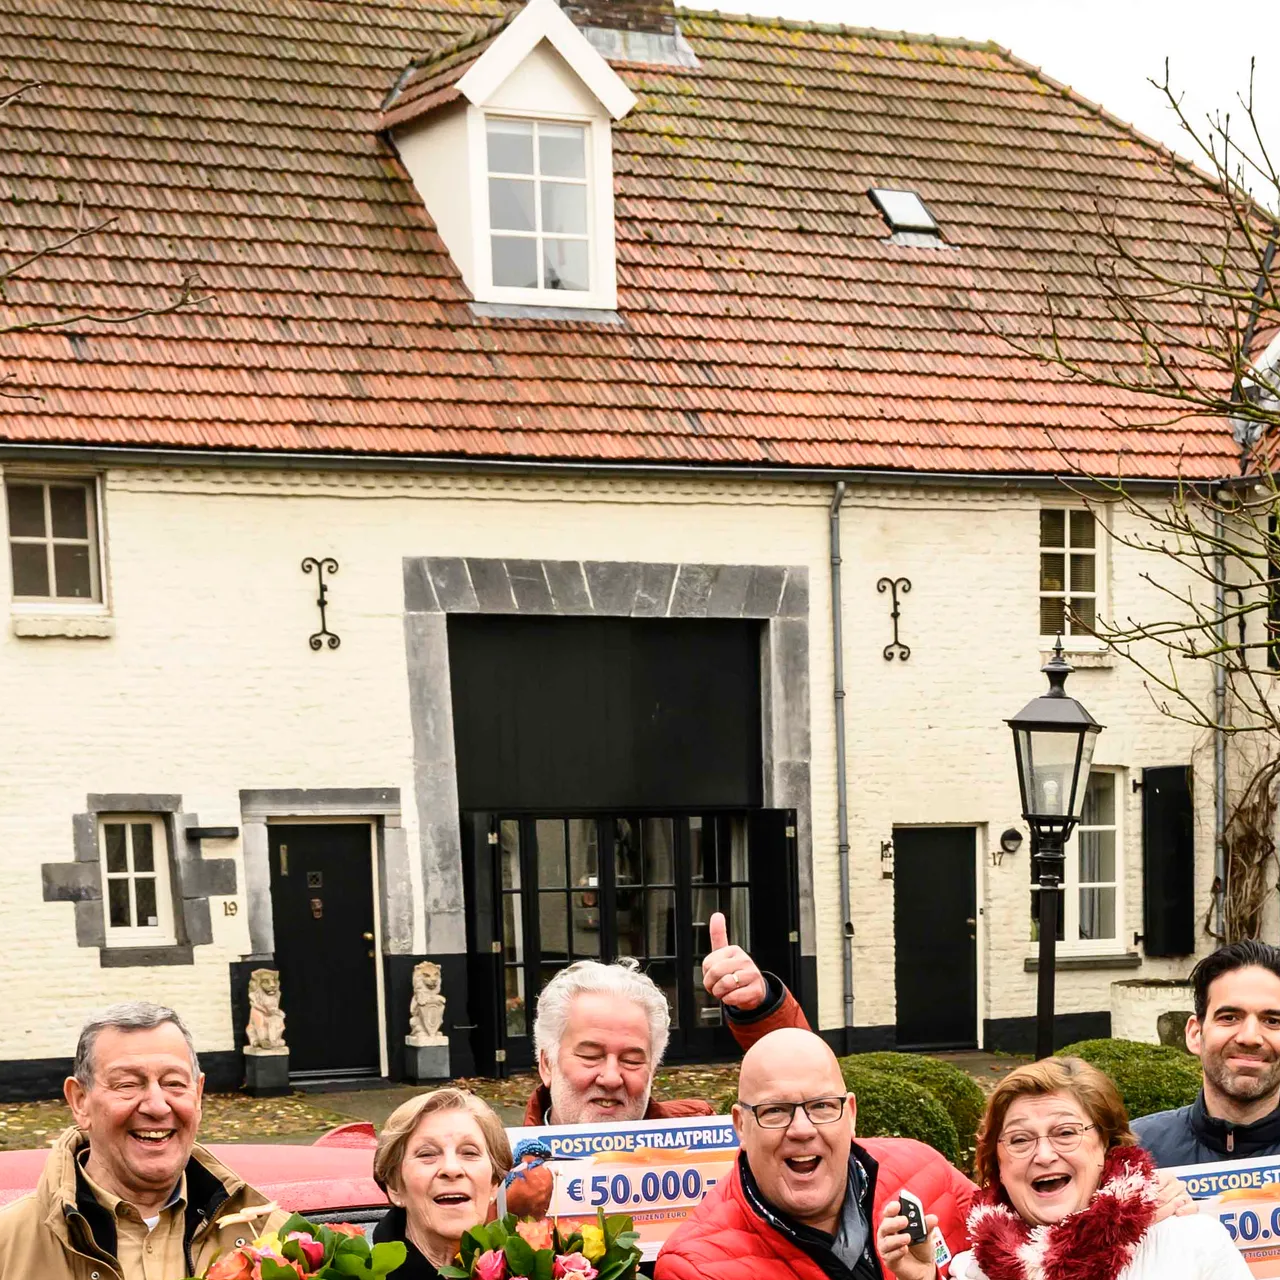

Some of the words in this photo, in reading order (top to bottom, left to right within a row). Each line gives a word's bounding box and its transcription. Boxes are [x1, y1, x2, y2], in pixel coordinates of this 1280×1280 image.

[992, 851, 1005, 866] 17
[222, 900, 238, 916] 19
[550, 1134, 634, 1153] POSTCODE
[635, 1128, 733, 1149] STRAATPRIJS
[1186, 1172, 1262, 1194] OSTCODE
[667, 1211, 687, 1219] EURO
